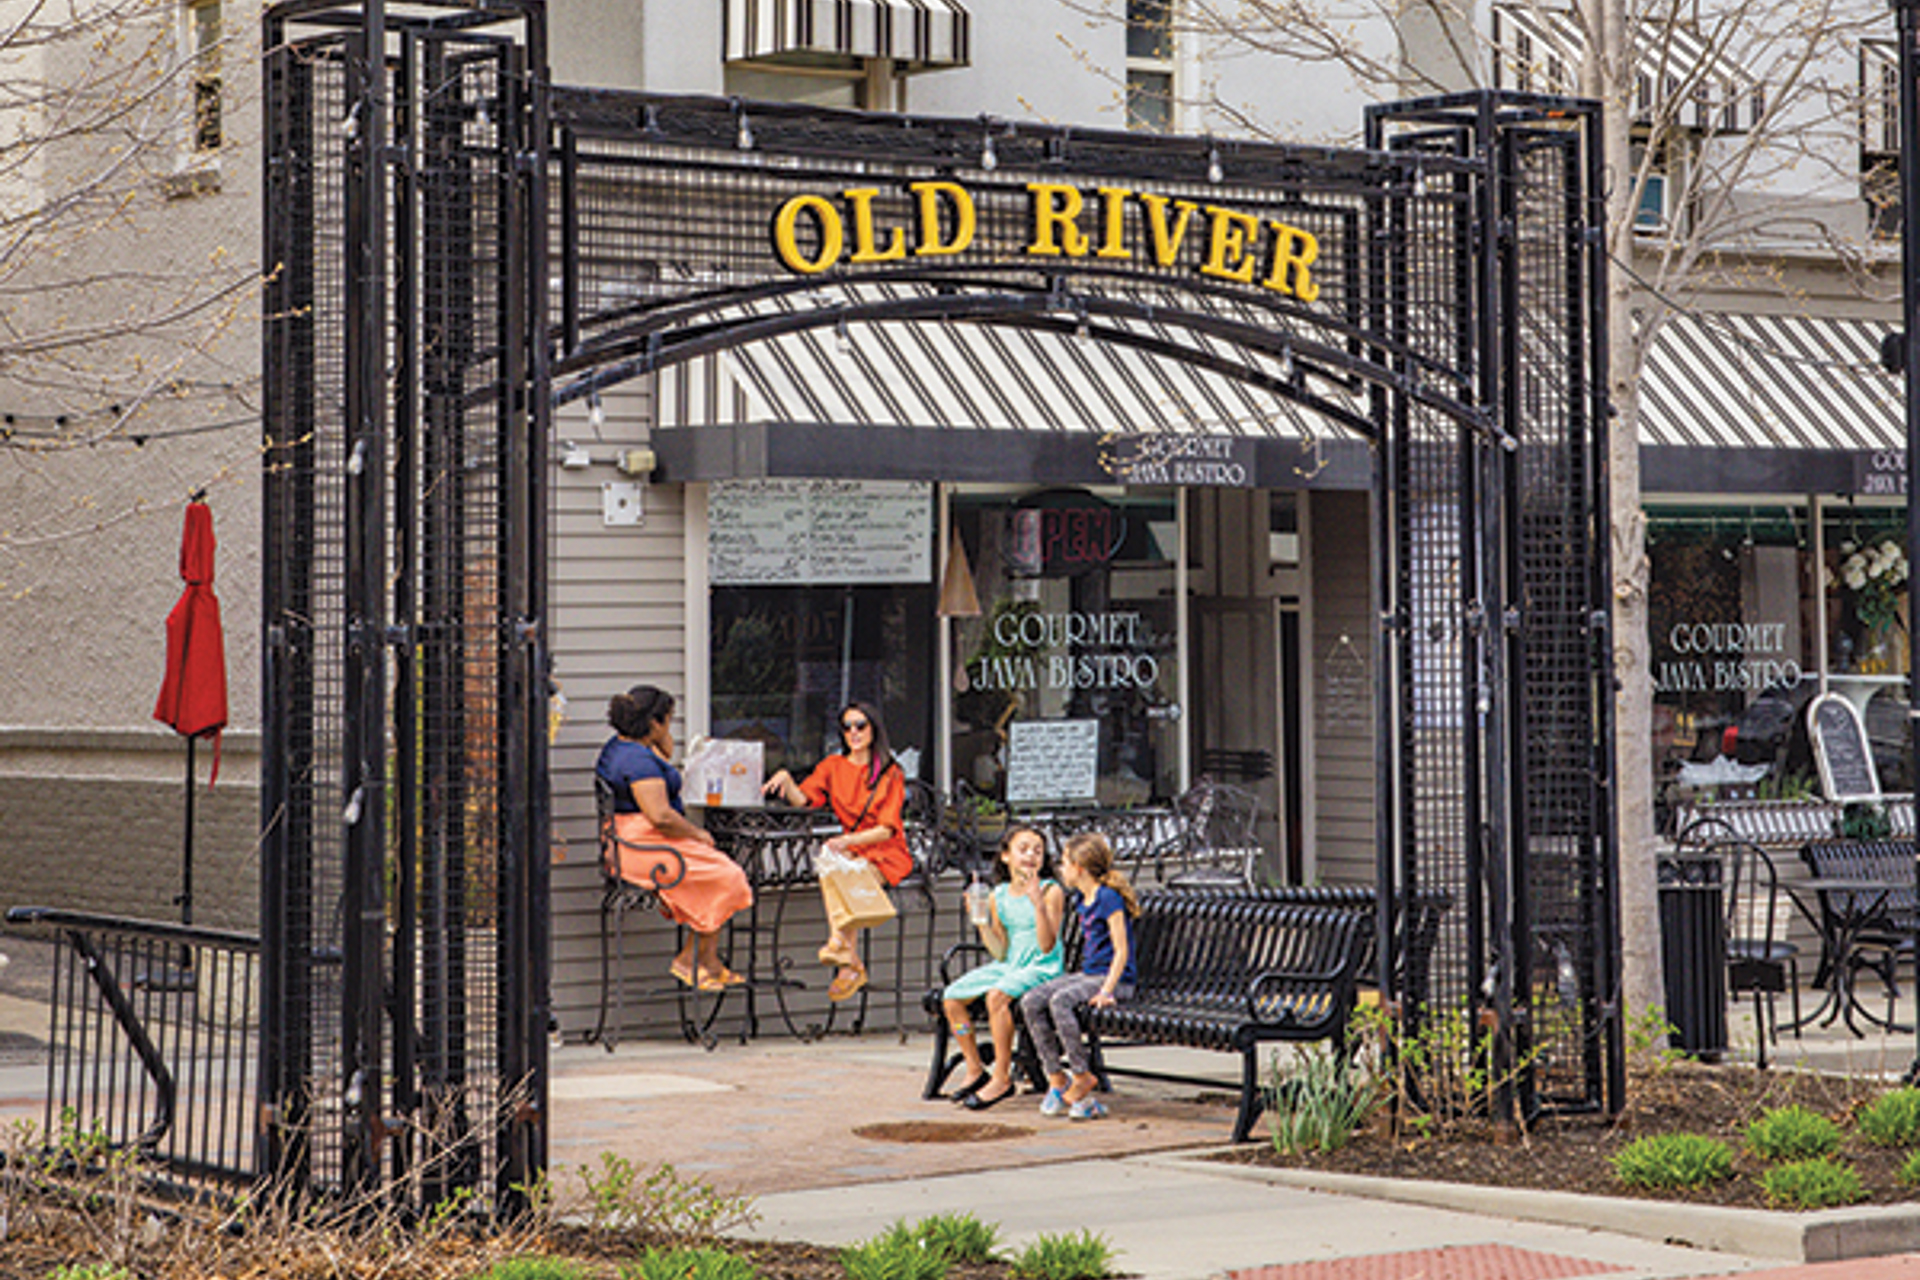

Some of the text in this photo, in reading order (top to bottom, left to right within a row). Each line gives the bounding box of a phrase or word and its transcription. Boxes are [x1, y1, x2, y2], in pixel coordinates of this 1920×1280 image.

[775, 180, 1320, 303] OLD RIVER
[1128, 462, 1246, 486] JAVA BISTRO
[1013, 508, 1112, 562] OPEN
[993, 612, 1140, 647] GOURMET
[1669, 622, 1786, 654] GOURMET
[971, 654, 1159, 692] JAVA BISTRO
[1655, 659, 1801, 692] JAVA BISTRO
